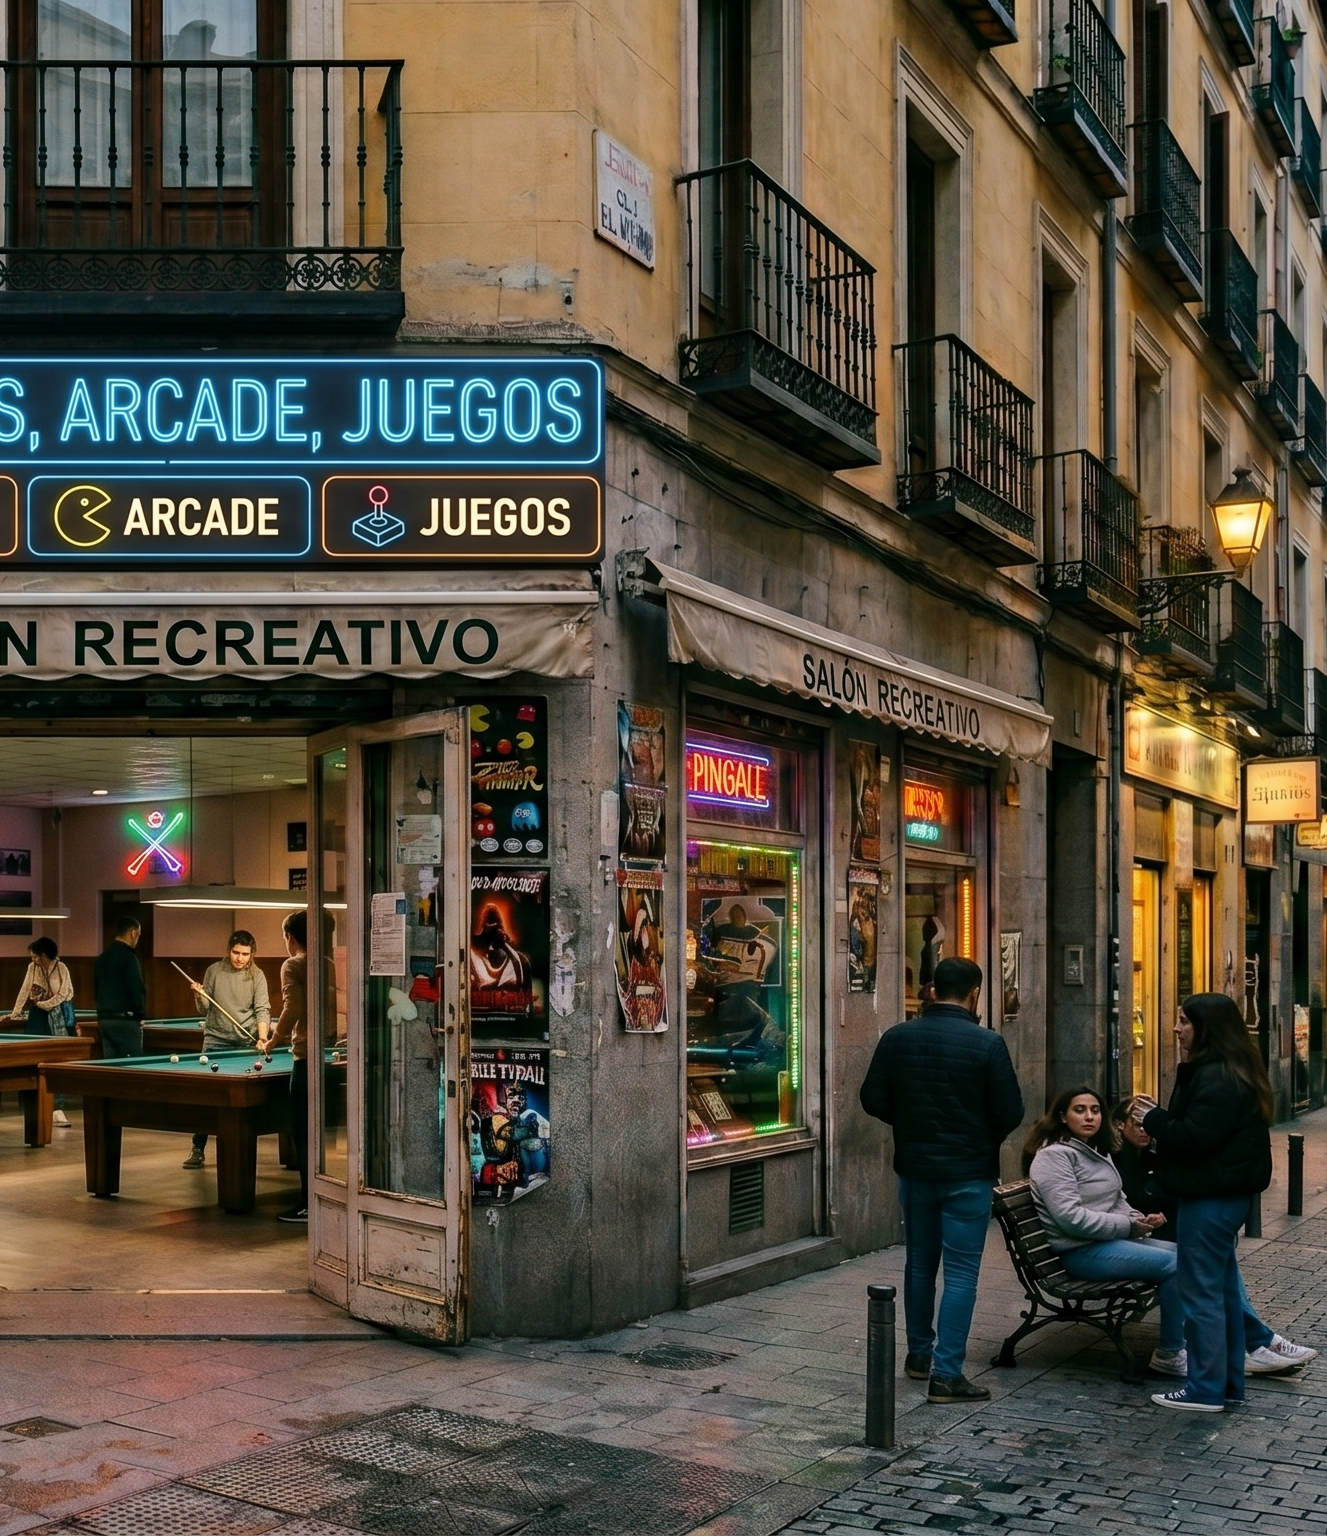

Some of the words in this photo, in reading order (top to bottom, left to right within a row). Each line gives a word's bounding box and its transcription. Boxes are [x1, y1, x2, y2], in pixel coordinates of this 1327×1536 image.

[60, 377, 322, 453] ARCADE,
[341, 377, 583, 443] JUEGOS
[123, 496, 280, 536] ARCADE
[419, 496, 571, 537] JUEGOS
[73, 618, 500, 667] RECREATIVO
[803, 653, 868, 707] SALÓN
[877, 678, 980, 740] RECREATIVO
